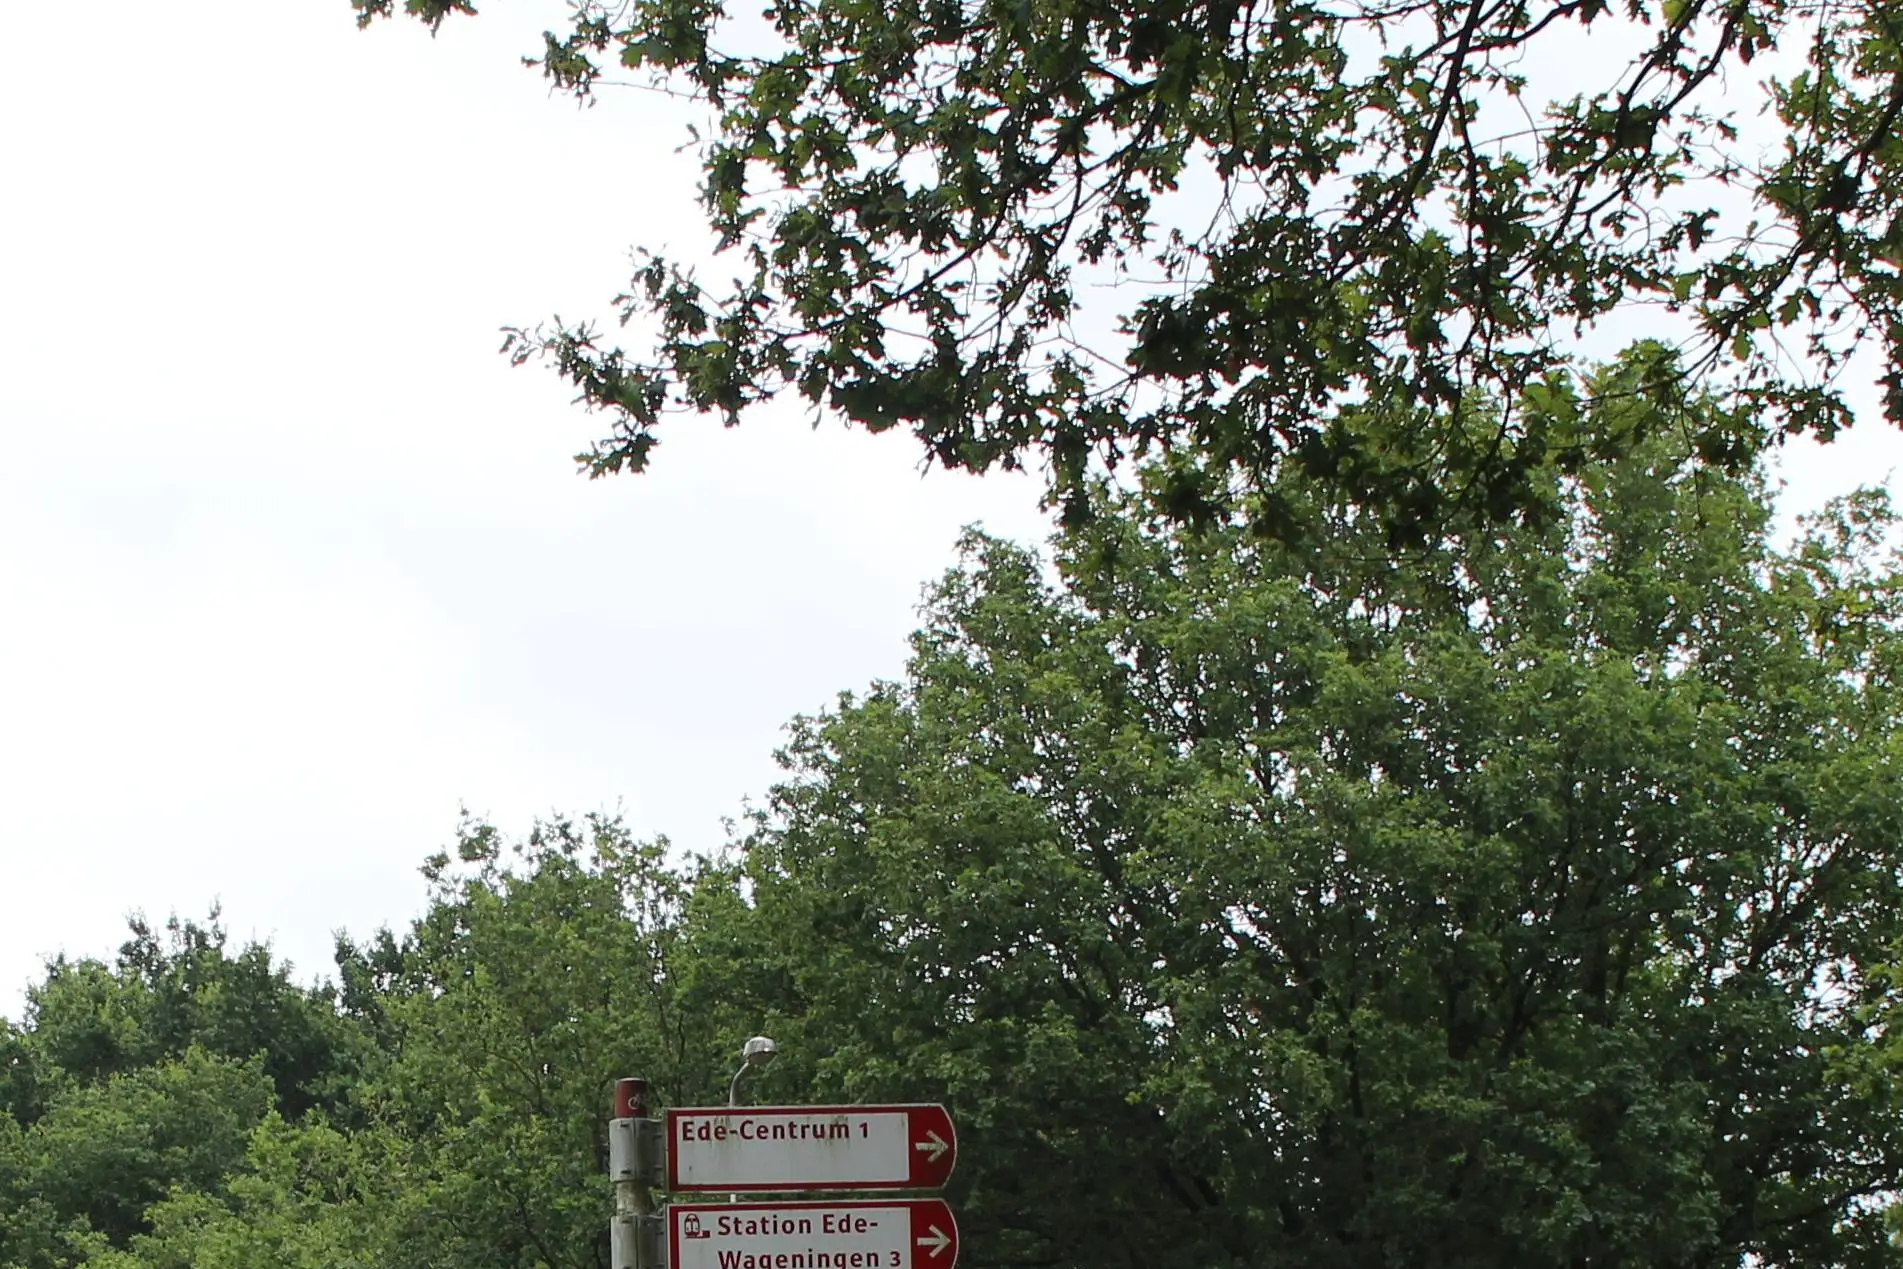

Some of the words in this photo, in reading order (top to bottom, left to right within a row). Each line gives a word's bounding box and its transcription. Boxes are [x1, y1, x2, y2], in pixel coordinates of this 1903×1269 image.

[682, 1119, 850, 1141] Ede-Centrum
[859, 1122, 869, 1139] 1
[718, 1214, 812, 1236] Station
[822, 1213, 878, 1234] Ede-
[889, 1250, 901, 1268] 3
